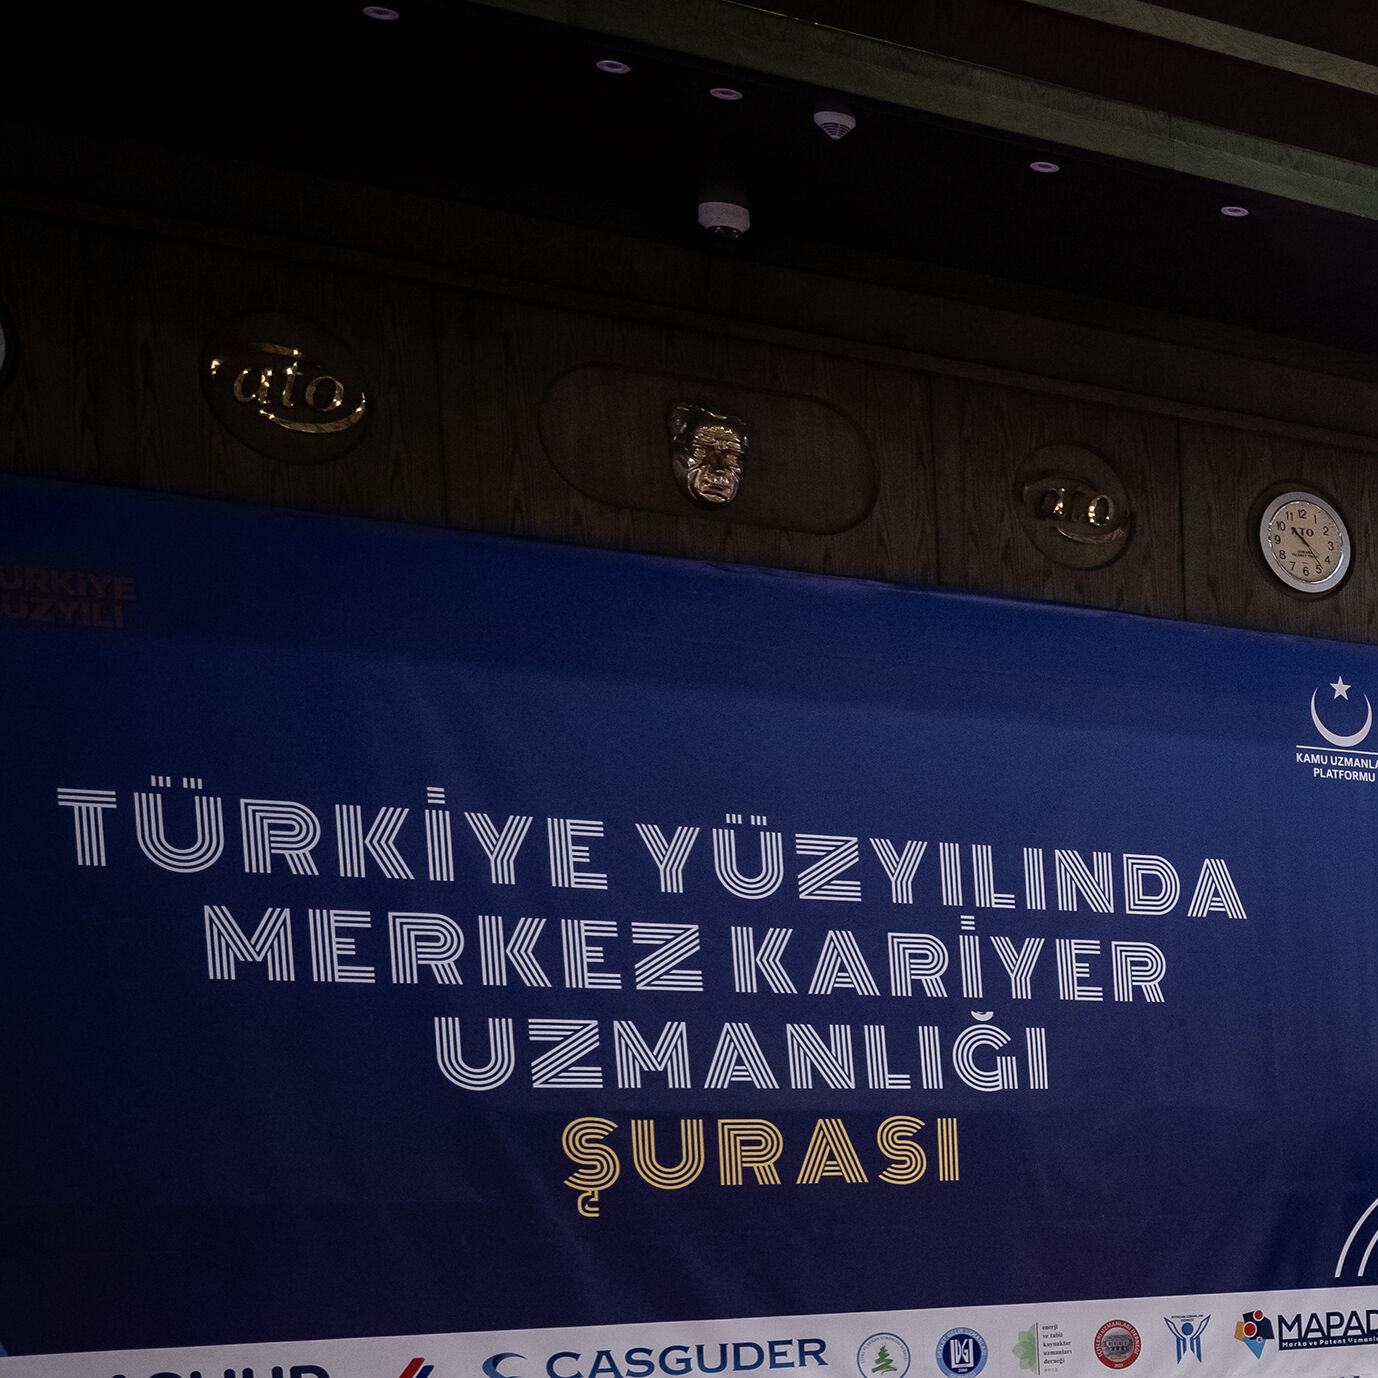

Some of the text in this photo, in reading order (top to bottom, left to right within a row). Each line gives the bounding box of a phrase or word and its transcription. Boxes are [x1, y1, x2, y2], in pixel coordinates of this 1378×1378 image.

[234, 361, 344, 412] ato
[1286, 511, 1294, 521] 11
[1298, 509, 1307, 519] 12
[1313, 514, 1318, 524] 1
[1276, 521, 1286, 531] 10
[1322, 526, 1329, 536] 2
[1275, 535, 1281, 544] 9
[1328, 541, 1334, 551] 3
[1279, 550, 1286, 559] 8
[1325, 556, 1330, 564] 4
[1290, 561, 1296, 571] 7
[1316, 564, 1323, 574] 5
[1303, 567, 1309, 576] 6
[1296, 753, 1327, 765] KAMU
[1313, 768, 1375, 782] PLATFORMU
[57, 776, 1247, 919] TÜRKİYE YÜZYILINDA
[204, 905, 1167, 1002] MERKEZ KARİYER
[434, 1011, 1048, 1091] UZMANLIĞI
[561, 1116, 960, 1217] ŞURASI
